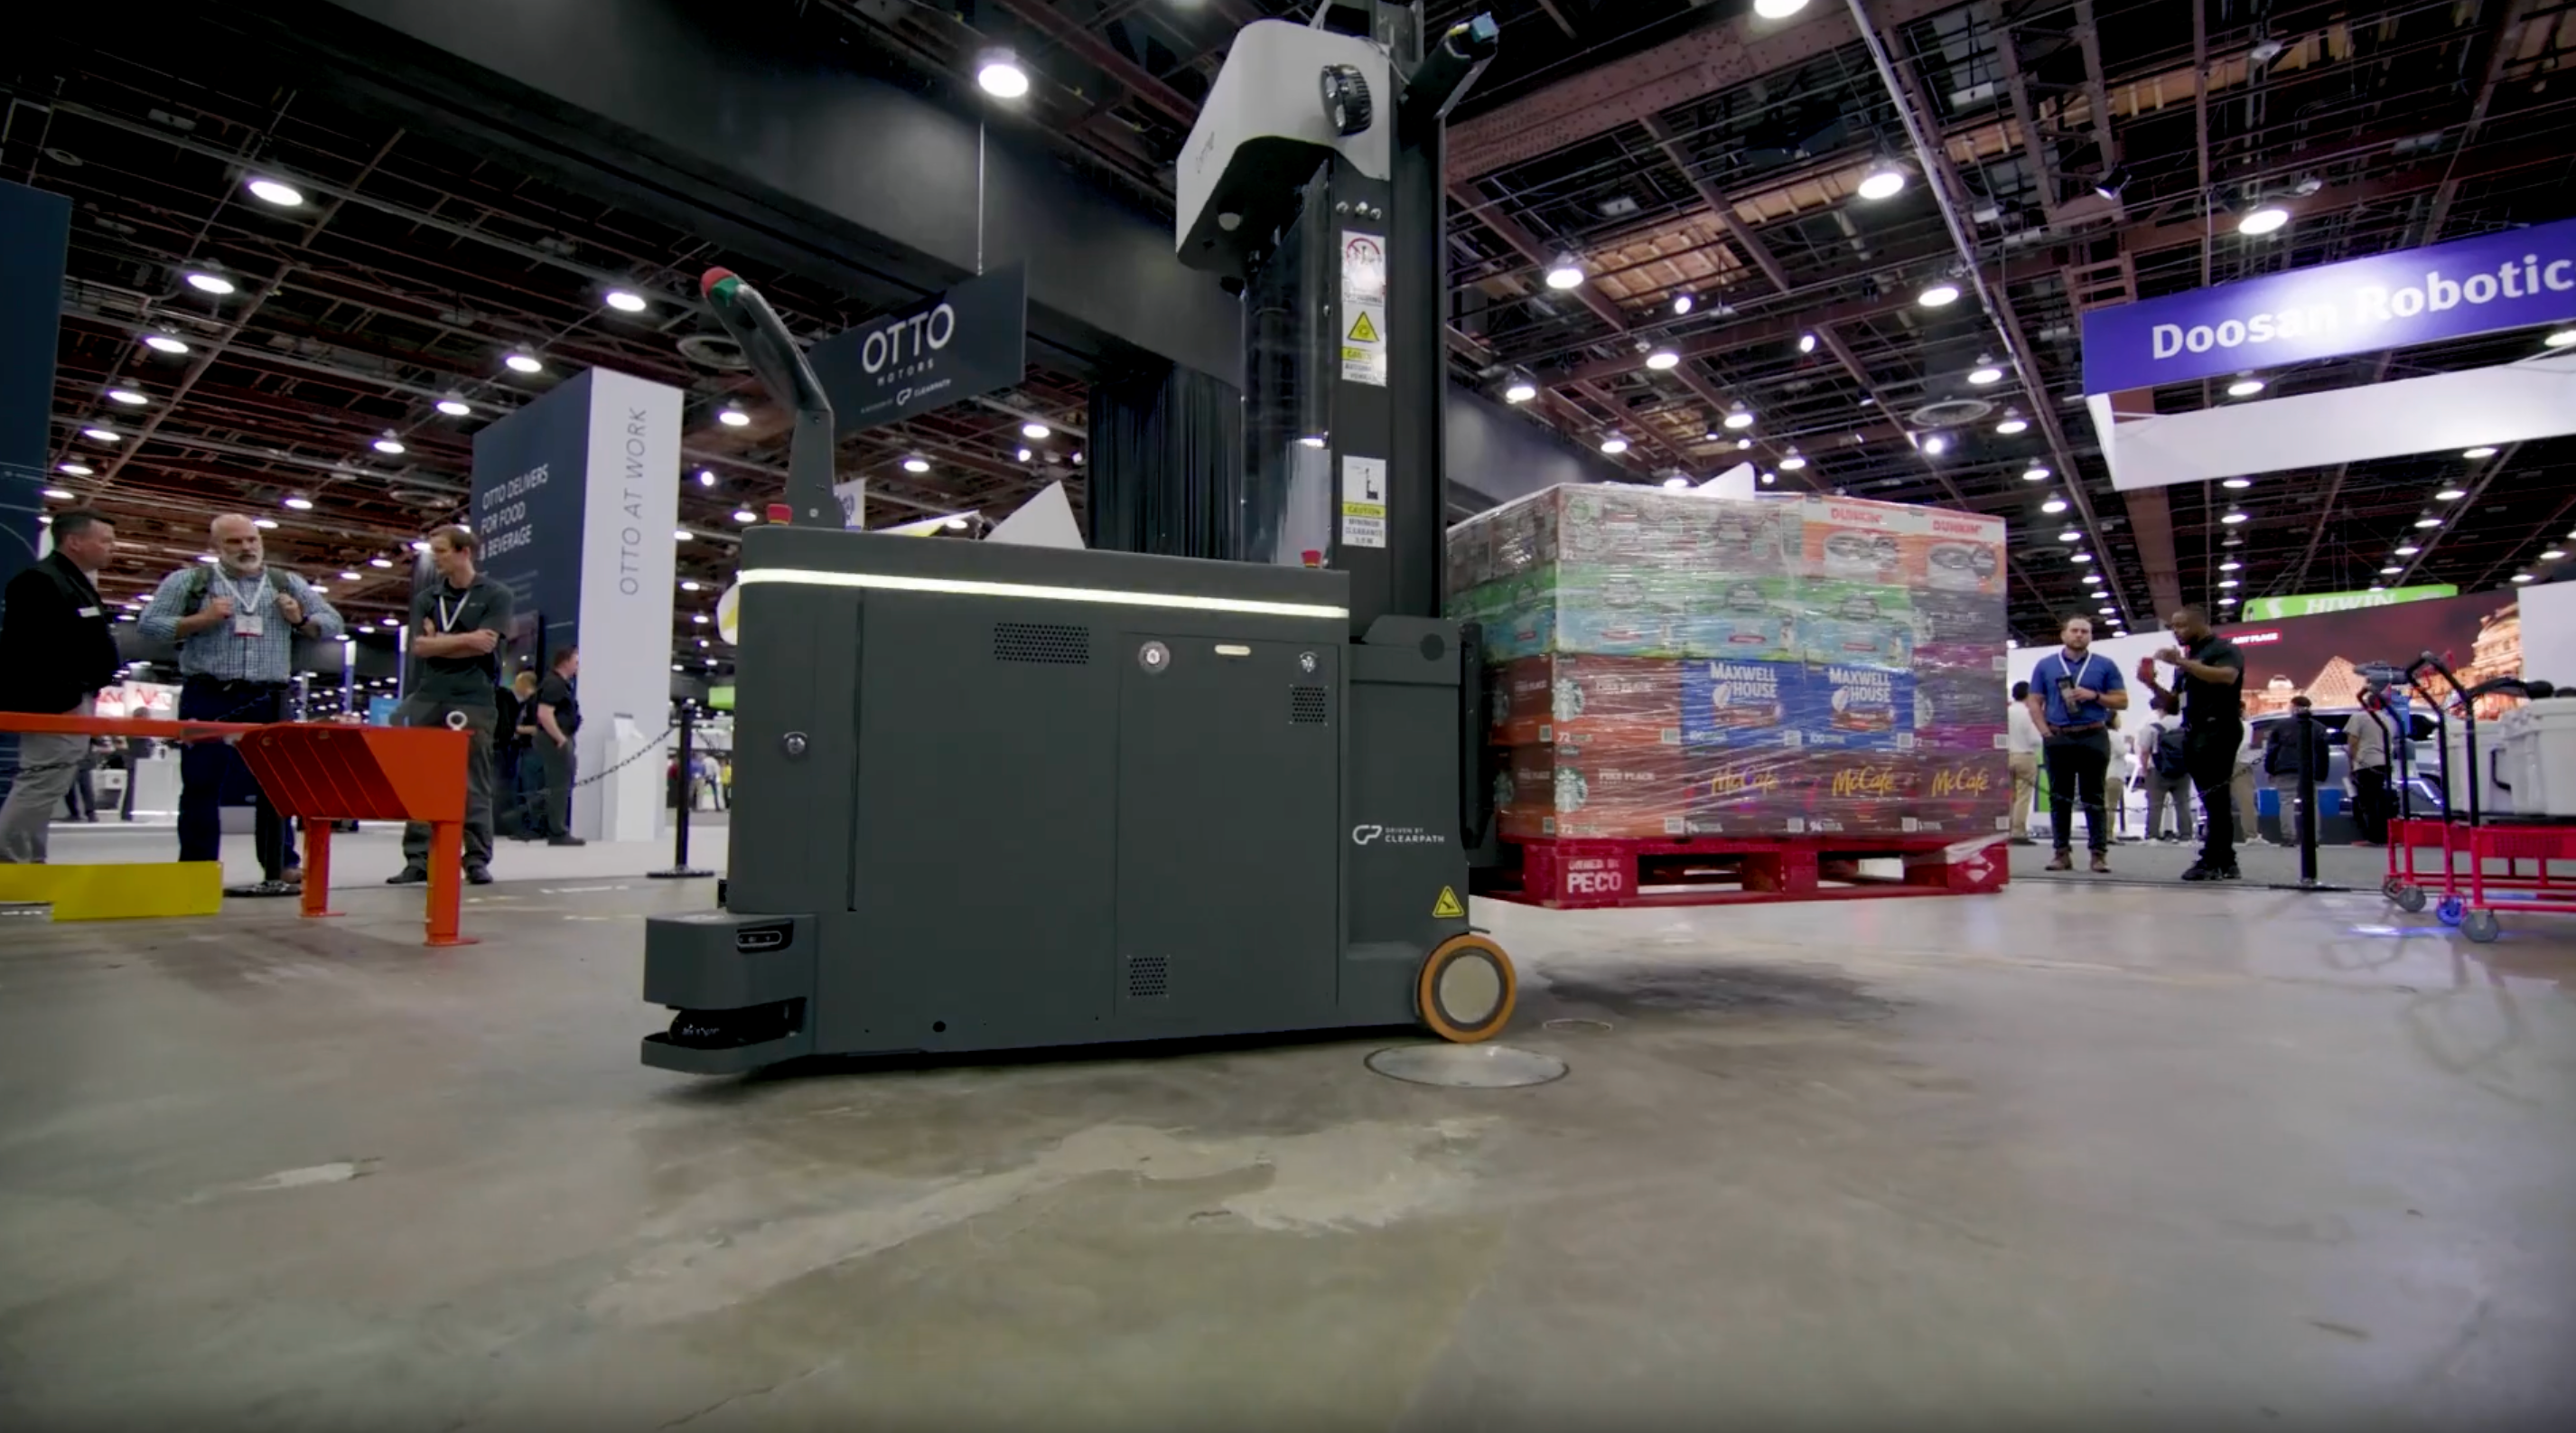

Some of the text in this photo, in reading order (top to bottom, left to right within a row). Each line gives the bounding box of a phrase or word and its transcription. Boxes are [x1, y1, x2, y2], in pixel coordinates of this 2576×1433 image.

[862, 303, 955, 374] OTTO
[2151, 299, 2338, 361] Doosan
[877, 358, 934, 387] MOTORS
[481, 463, 549, 511] OTTO DELIVERS
[619, 407, 647, 595] OTTO AT WORK
[481, 501, 526, 536] FOR FOOD
[488, 523, 533, 558] BEVERAGE
[1710, 661, 1778, 682] MAXWELL
[1829, 667, 1891, 685] MAXWELL
[1733, 682, 1778, 698] HOUSE
[1852, 687, 1891, 702] HOUSE
[1385, 835, 1445, 843] CLEARPATH
[1567, 872, 1622, 894] PECO
